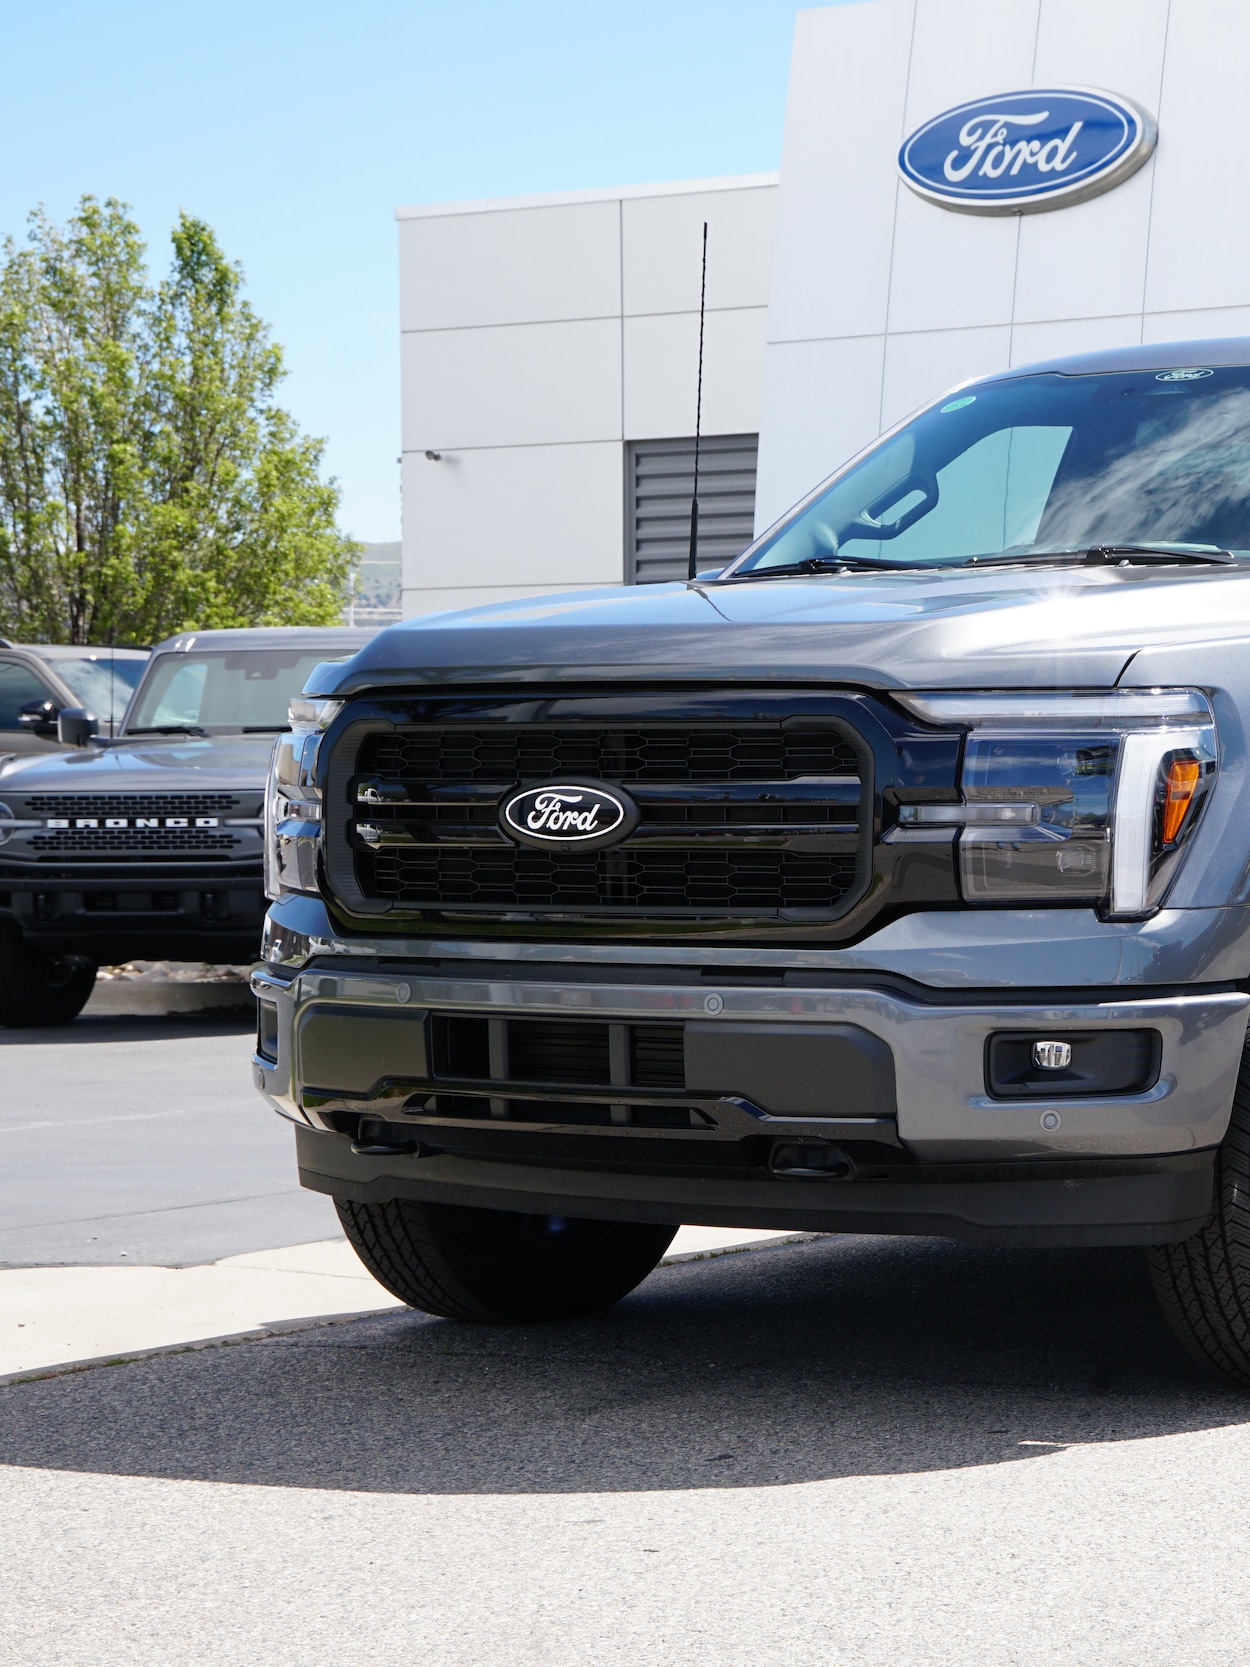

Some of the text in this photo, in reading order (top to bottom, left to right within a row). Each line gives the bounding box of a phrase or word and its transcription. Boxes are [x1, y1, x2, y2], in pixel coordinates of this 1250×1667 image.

[943, 110, 1084, 182] Ford
[46, 817, 219, 829] BRONCO
[527, 793, 601, 831] Ford
